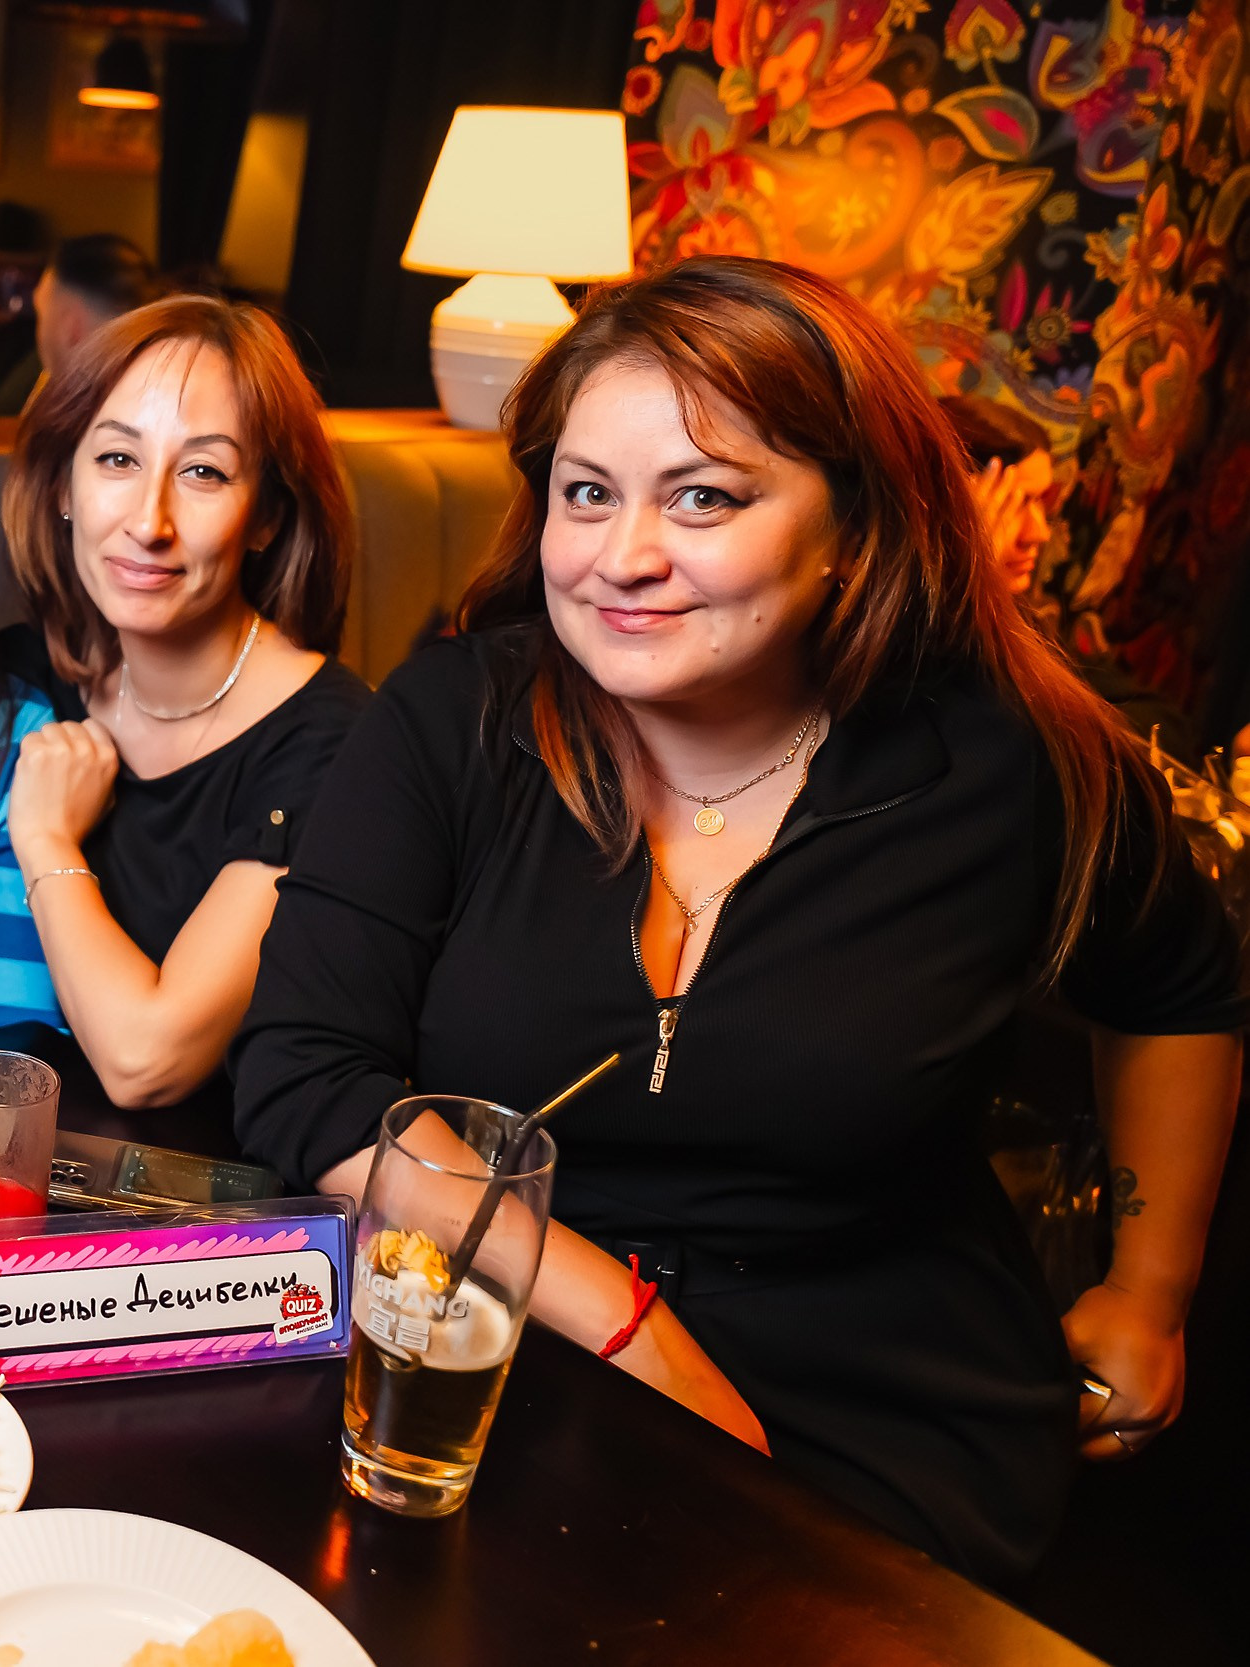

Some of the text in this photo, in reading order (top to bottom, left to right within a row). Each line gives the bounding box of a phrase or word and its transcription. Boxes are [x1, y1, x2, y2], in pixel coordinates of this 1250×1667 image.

[126, 1272, 297, 1313] Децибелки
[286, 1299, 316, 1313] QUIZ
[315, 1321, 328, 1329] GAME
